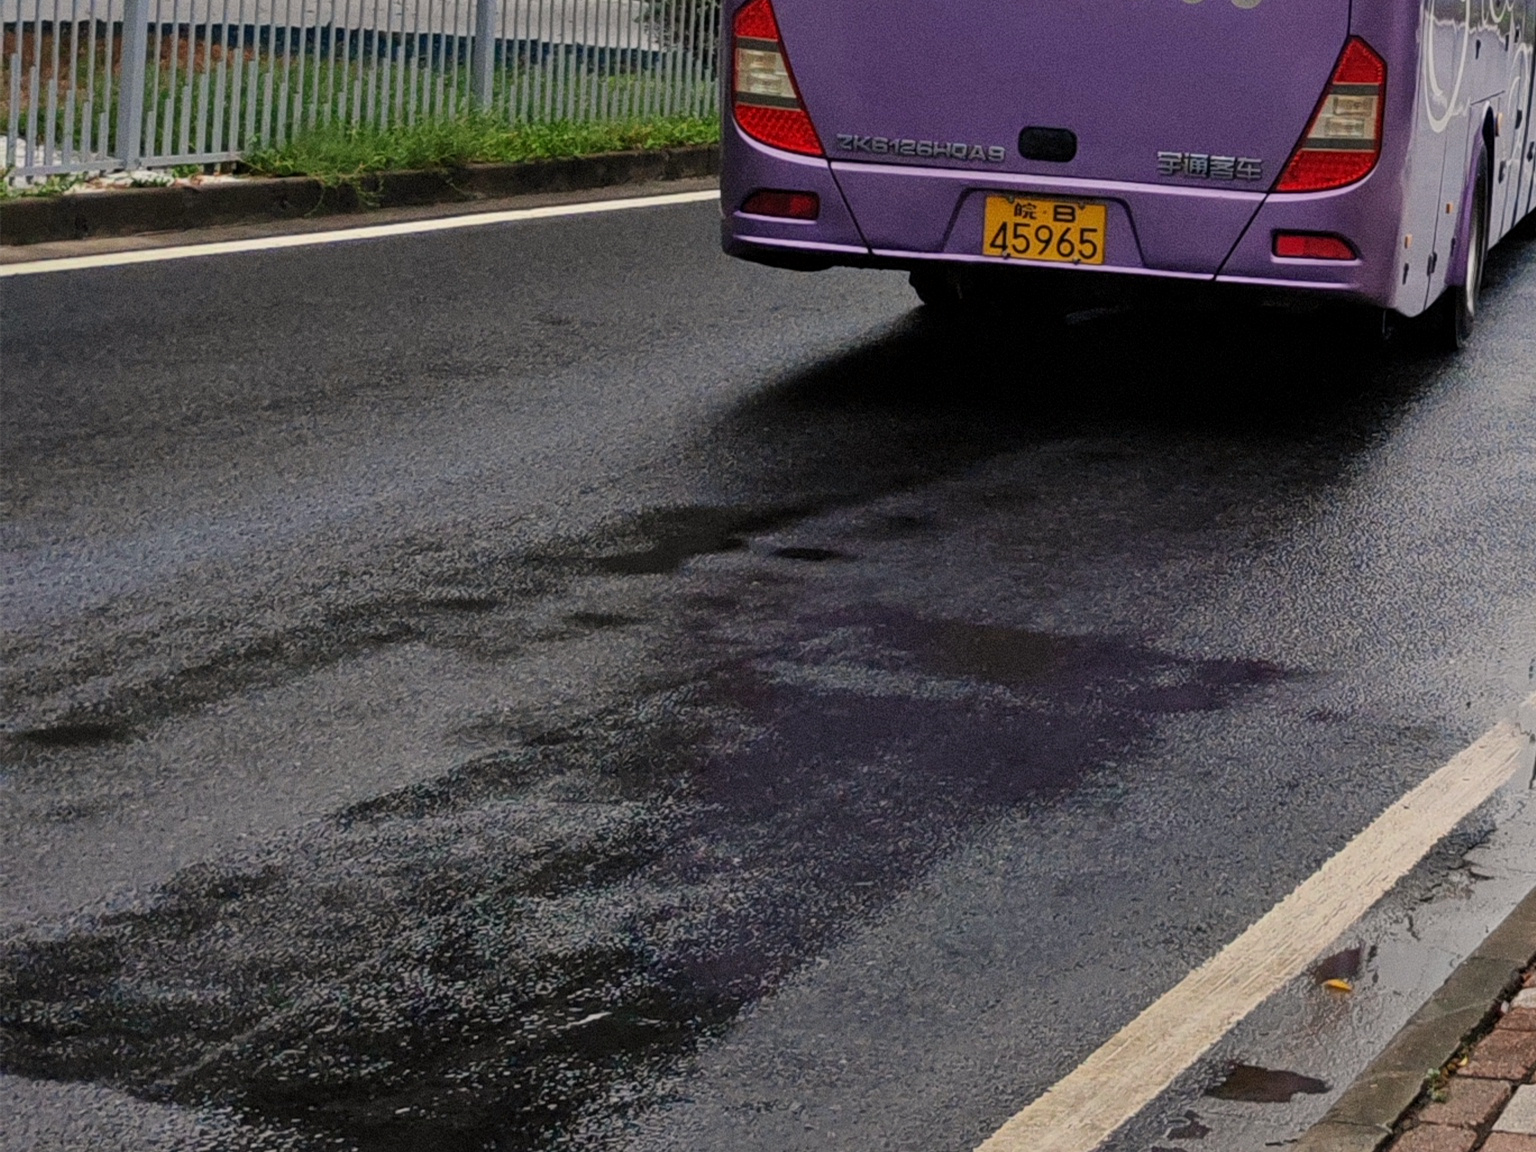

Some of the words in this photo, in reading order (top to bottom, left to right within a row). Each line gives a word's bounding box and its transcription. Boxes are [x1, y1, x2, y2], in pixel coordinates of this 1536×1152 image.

[1157, 151, 1262, 180] 宇通客车
[989, 221, 1098, 259] 45965
